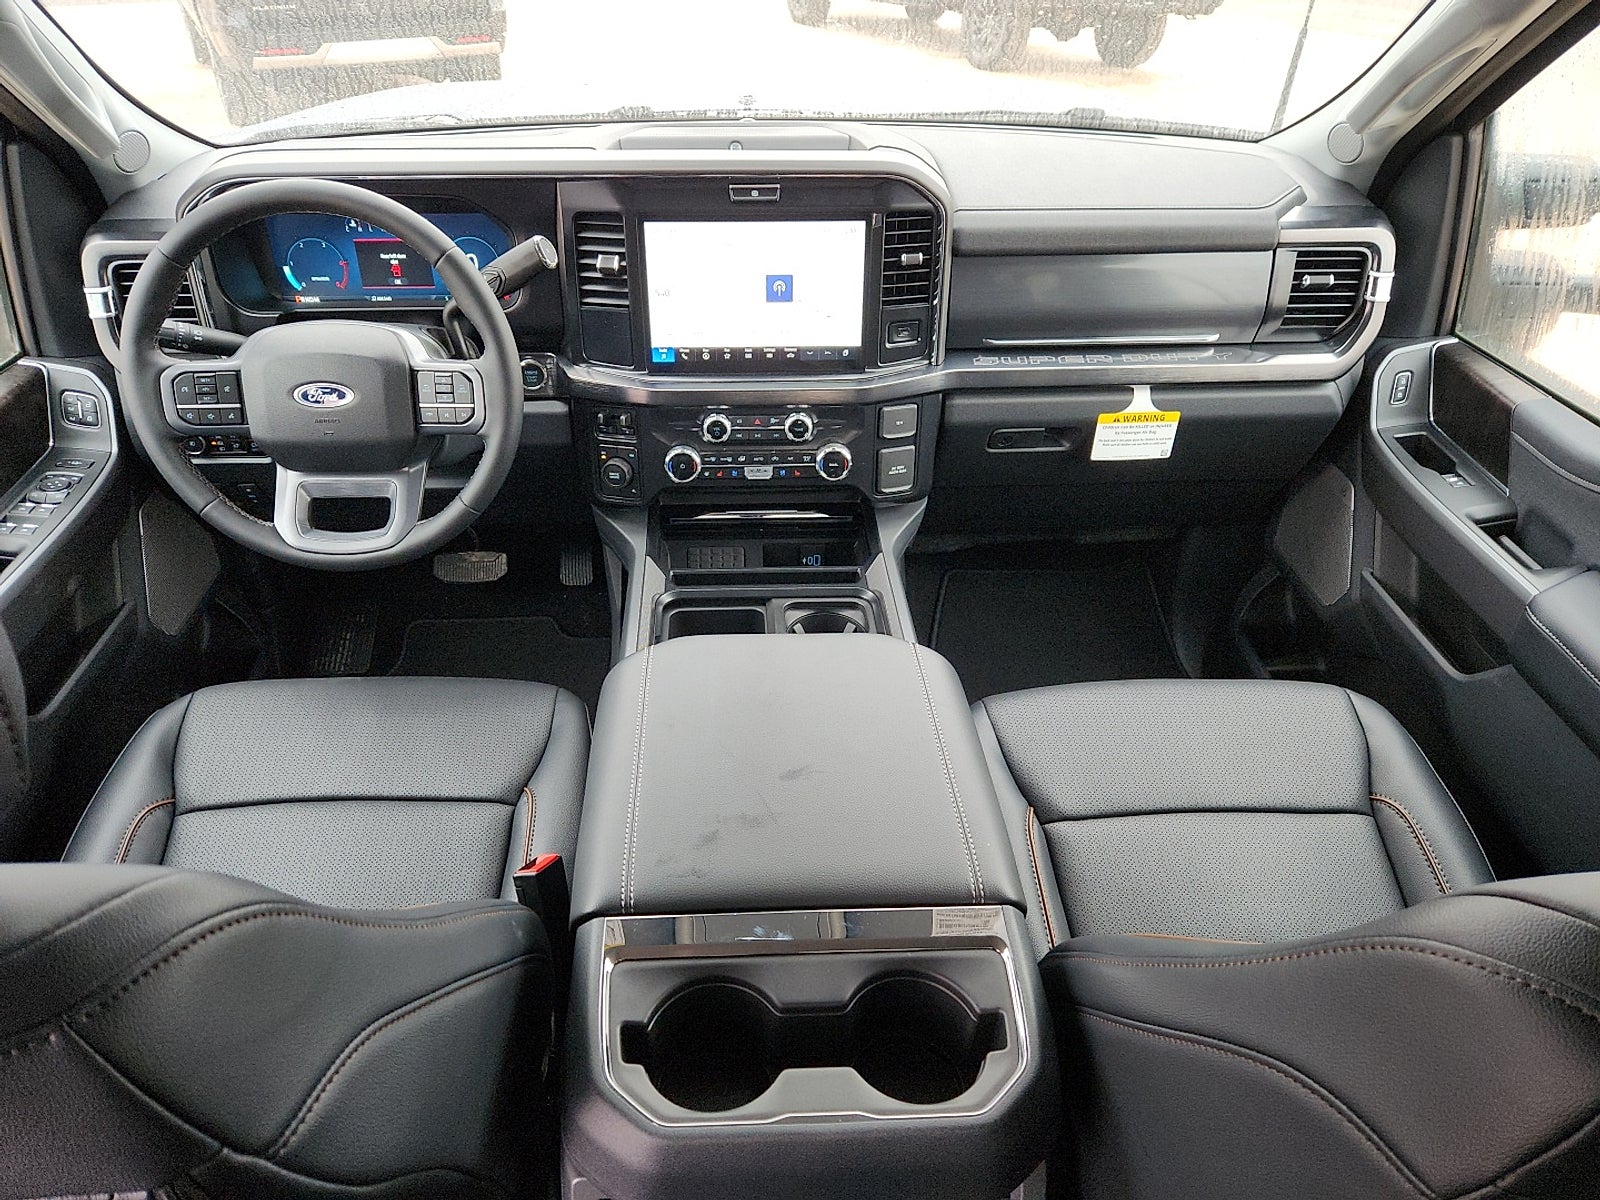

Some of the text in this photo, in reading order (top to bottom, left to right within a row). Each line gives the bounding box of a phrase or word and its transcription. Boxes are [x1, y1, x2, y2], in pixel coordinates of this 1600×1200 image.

[973, 354, 1113, 365] SUPER
[305, 386, 341, 403] Ford
[1123, 413, 1166, 423] WARNING
